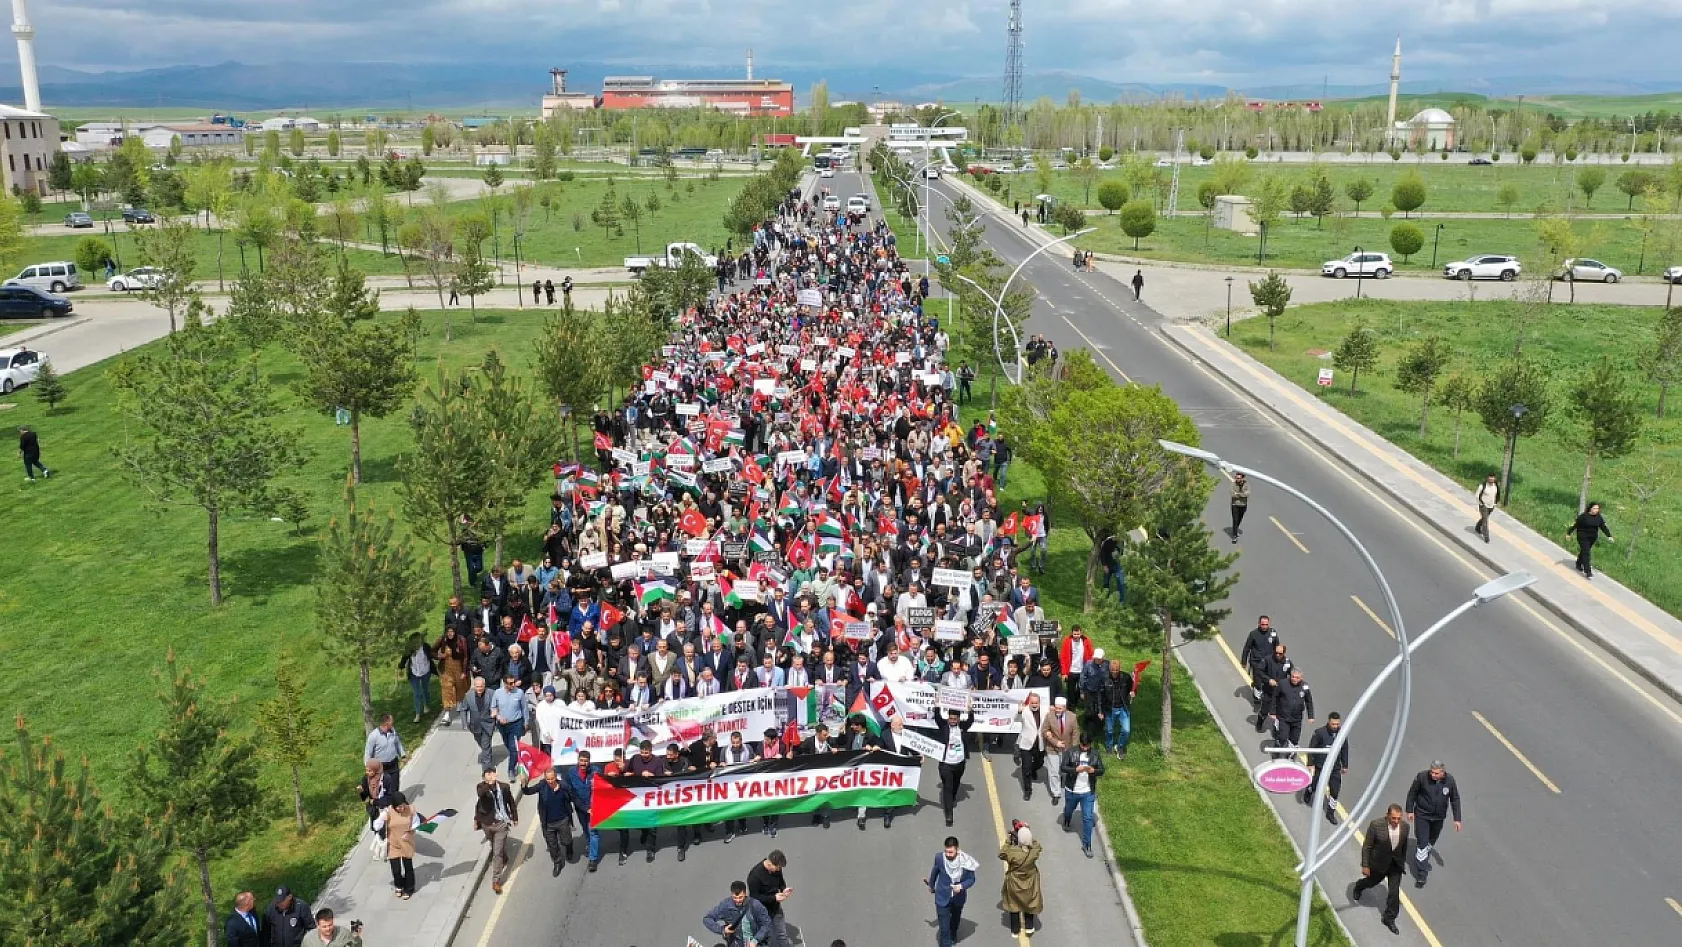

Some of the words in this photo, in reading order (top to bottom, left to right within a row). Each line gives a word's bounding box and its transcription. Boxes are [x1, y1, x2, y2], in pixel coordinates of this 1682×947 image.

[559, 716, 583, 730] GAZZE
[728, 698, 756, 715] DESTEK
[644, 778, 729, 807] FİLİSTİN
[735, 776, 809, 798] YALNIZ
[814, 766, 905, 792] DEĞİLSİN
